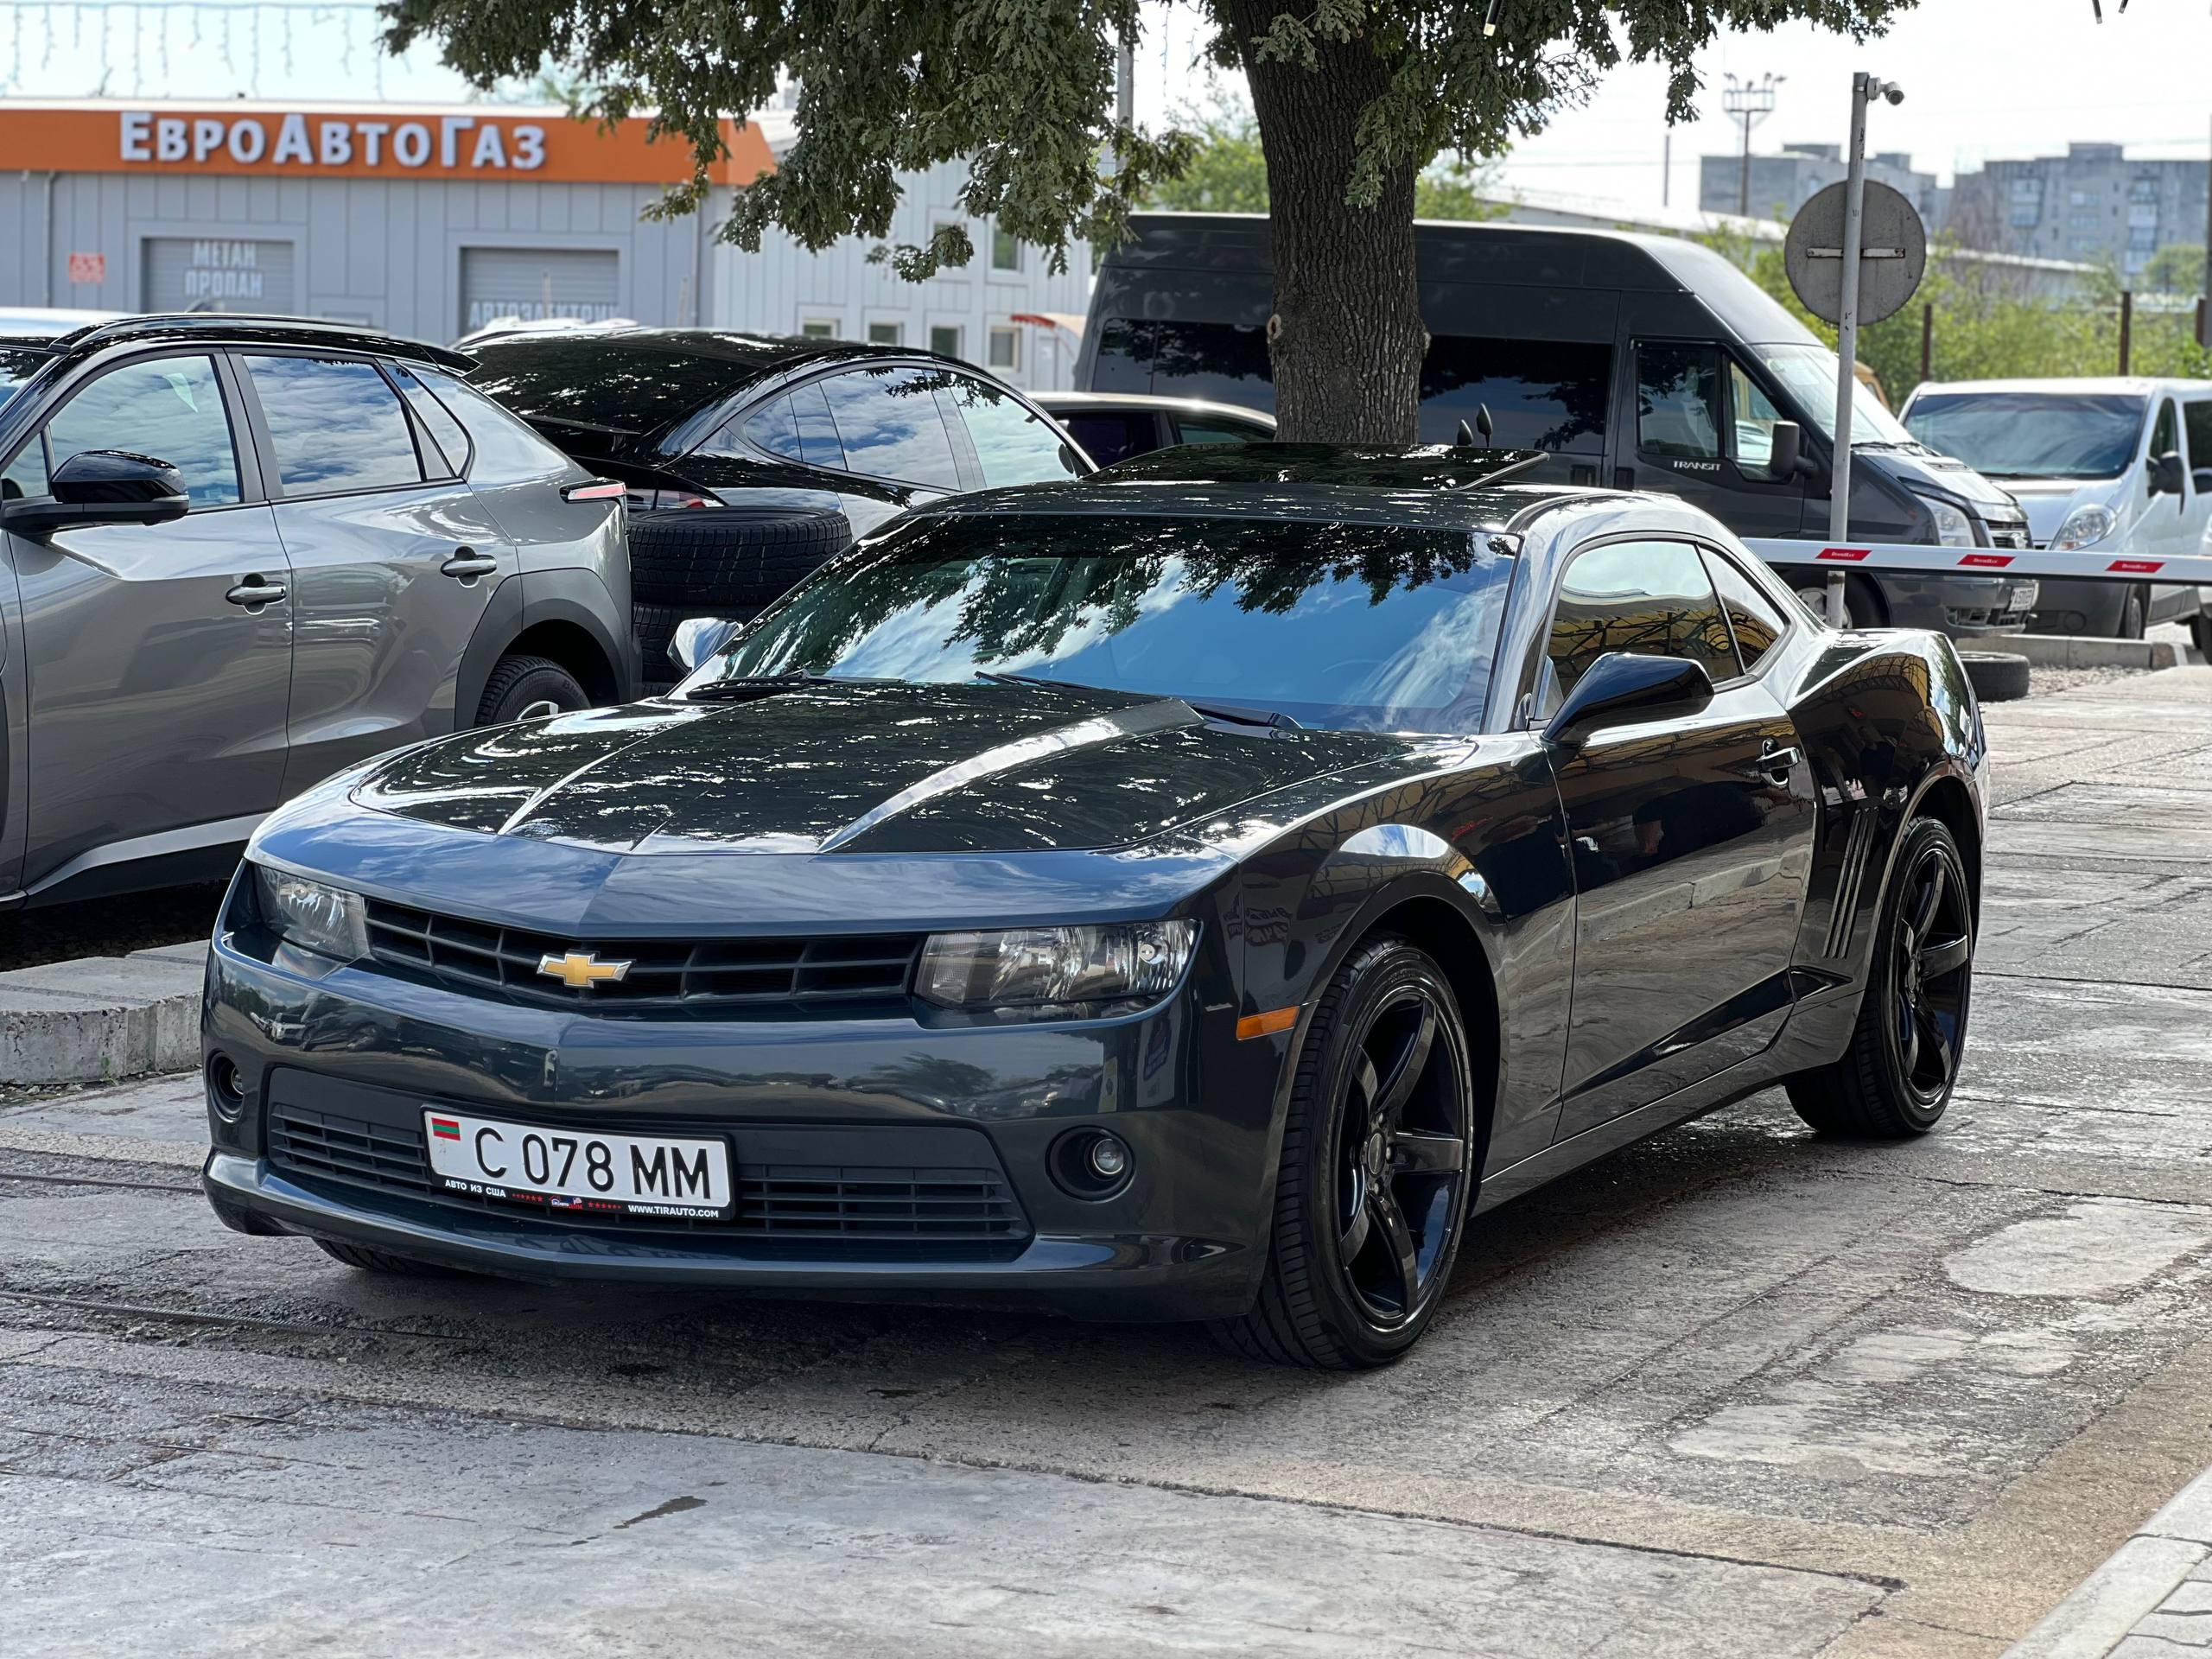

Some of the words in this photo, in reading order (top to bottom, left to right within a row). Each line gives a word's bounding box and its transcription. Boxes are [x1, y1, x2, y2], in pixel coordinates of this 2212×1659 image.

[193, 241, 256, 267] МЕТАН
[185, 270, 263, 296] ПРОПАН
[1673, 460, 1721, 471] TRANSIT
[474, 1127, 507, 1179] C
[522, 1133, 614, 1192] 078
[629, 1144, 711, 1199] MM
[445, 1179, 467, 1191] АВТО
[470, 1184, 483, 1193] ИЗ
[486, 1187, 506, 1198] США
[628, 1205, 719, 1217] WWW.TIRAUTO.COM
